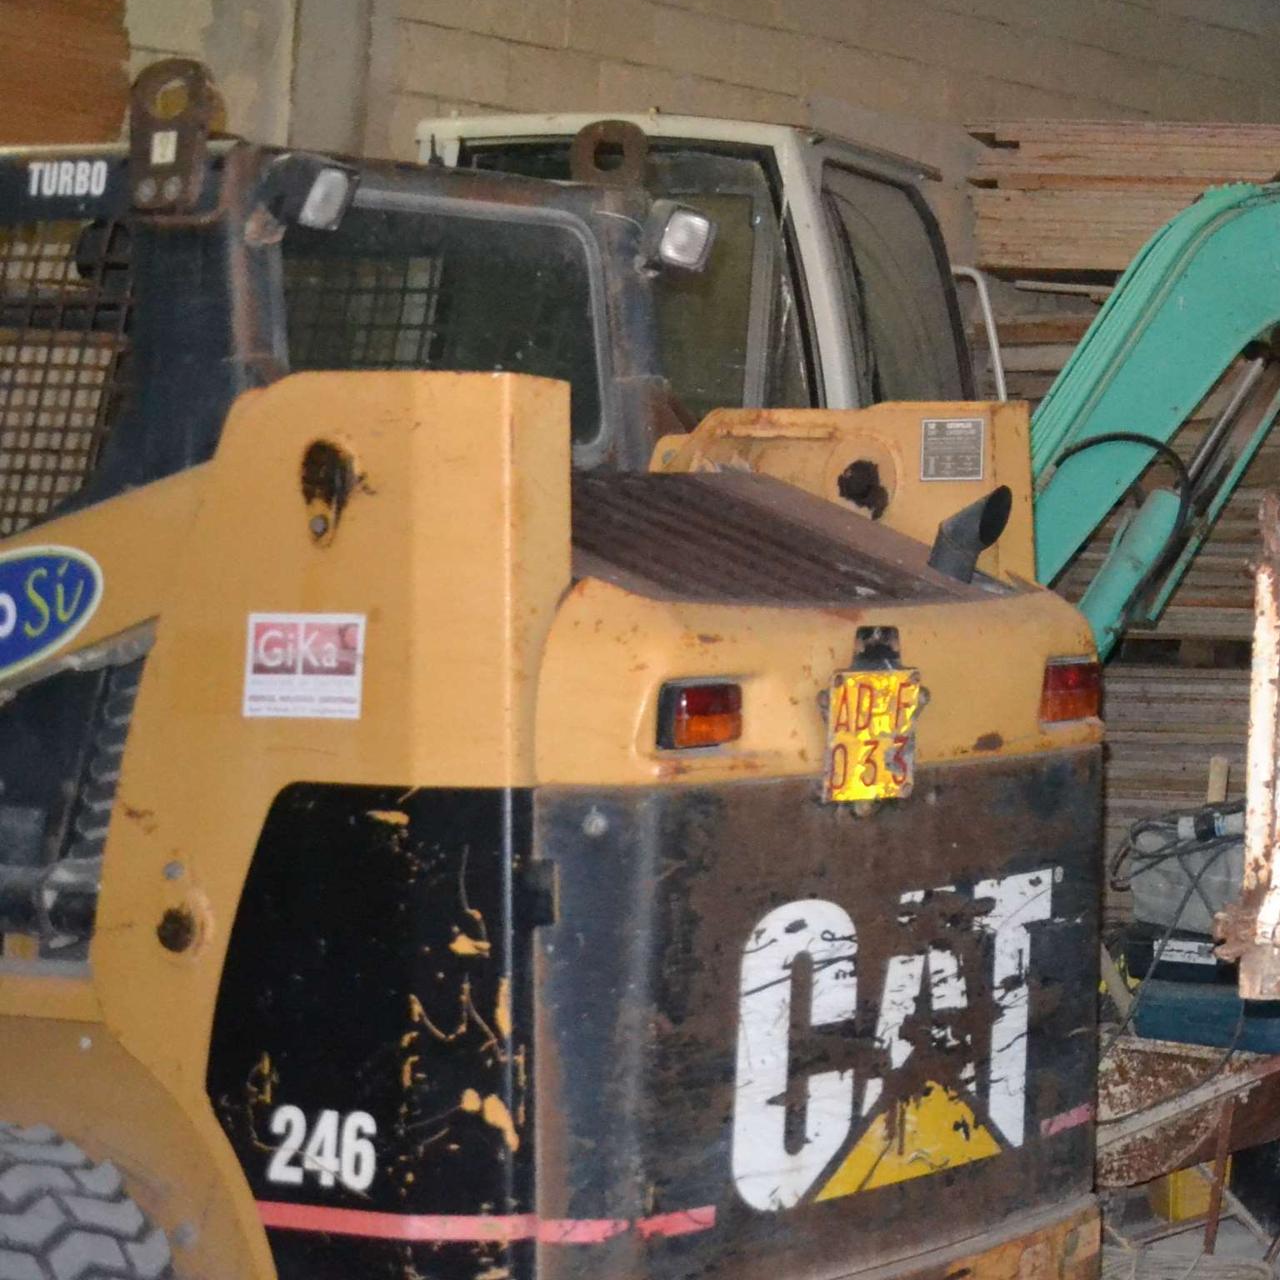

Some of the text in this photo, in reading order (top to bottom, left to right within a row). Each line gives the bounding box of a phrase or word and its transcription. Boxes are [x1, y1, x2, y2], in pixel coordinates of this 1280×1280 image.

[27, 160, 108, 197] TURBO
[732, 868, 1052, 1211] CAT
[267, 1105, 377, 1191] 246
